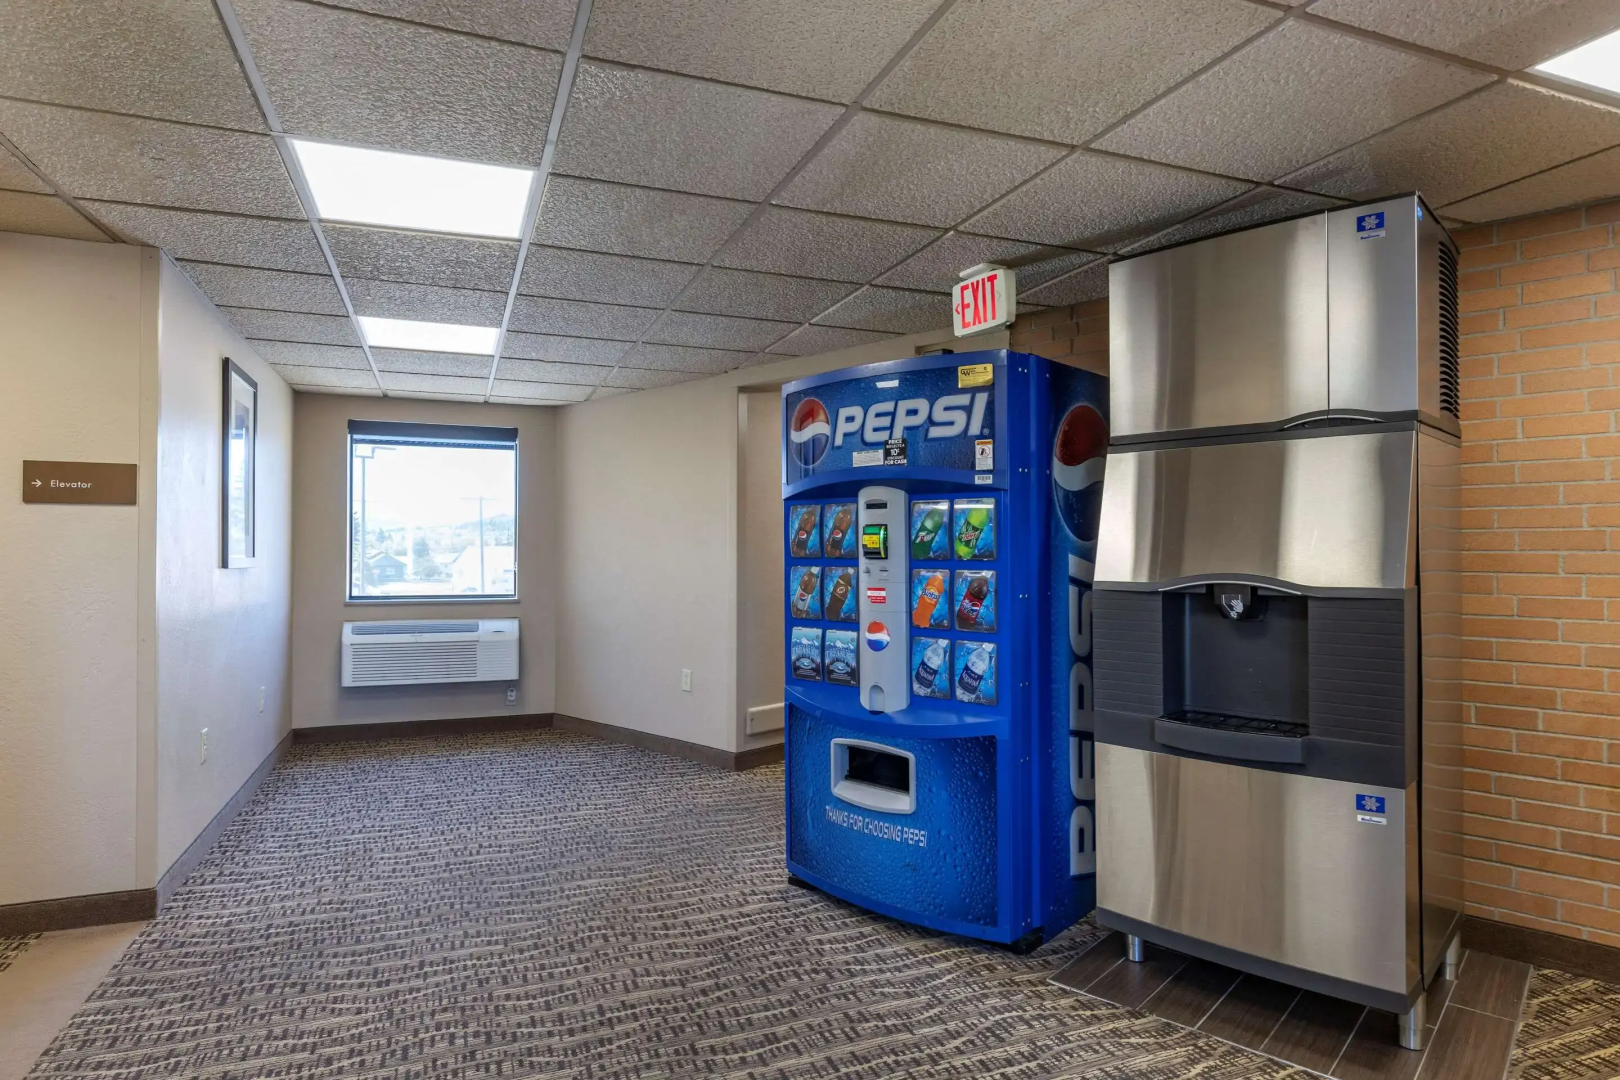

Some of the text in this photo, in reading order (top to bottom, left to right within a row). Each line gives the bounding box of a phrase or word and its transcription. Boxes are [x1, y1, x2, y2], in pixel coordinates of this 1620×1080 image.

[960, 273, 998, 329] EXIT
[833, 392, 989, 447] PEPSI
[50, 480, 93, 489] Elevator
[825, 805, 928, 847] THANKS FOR CHOOSING PEPSI
